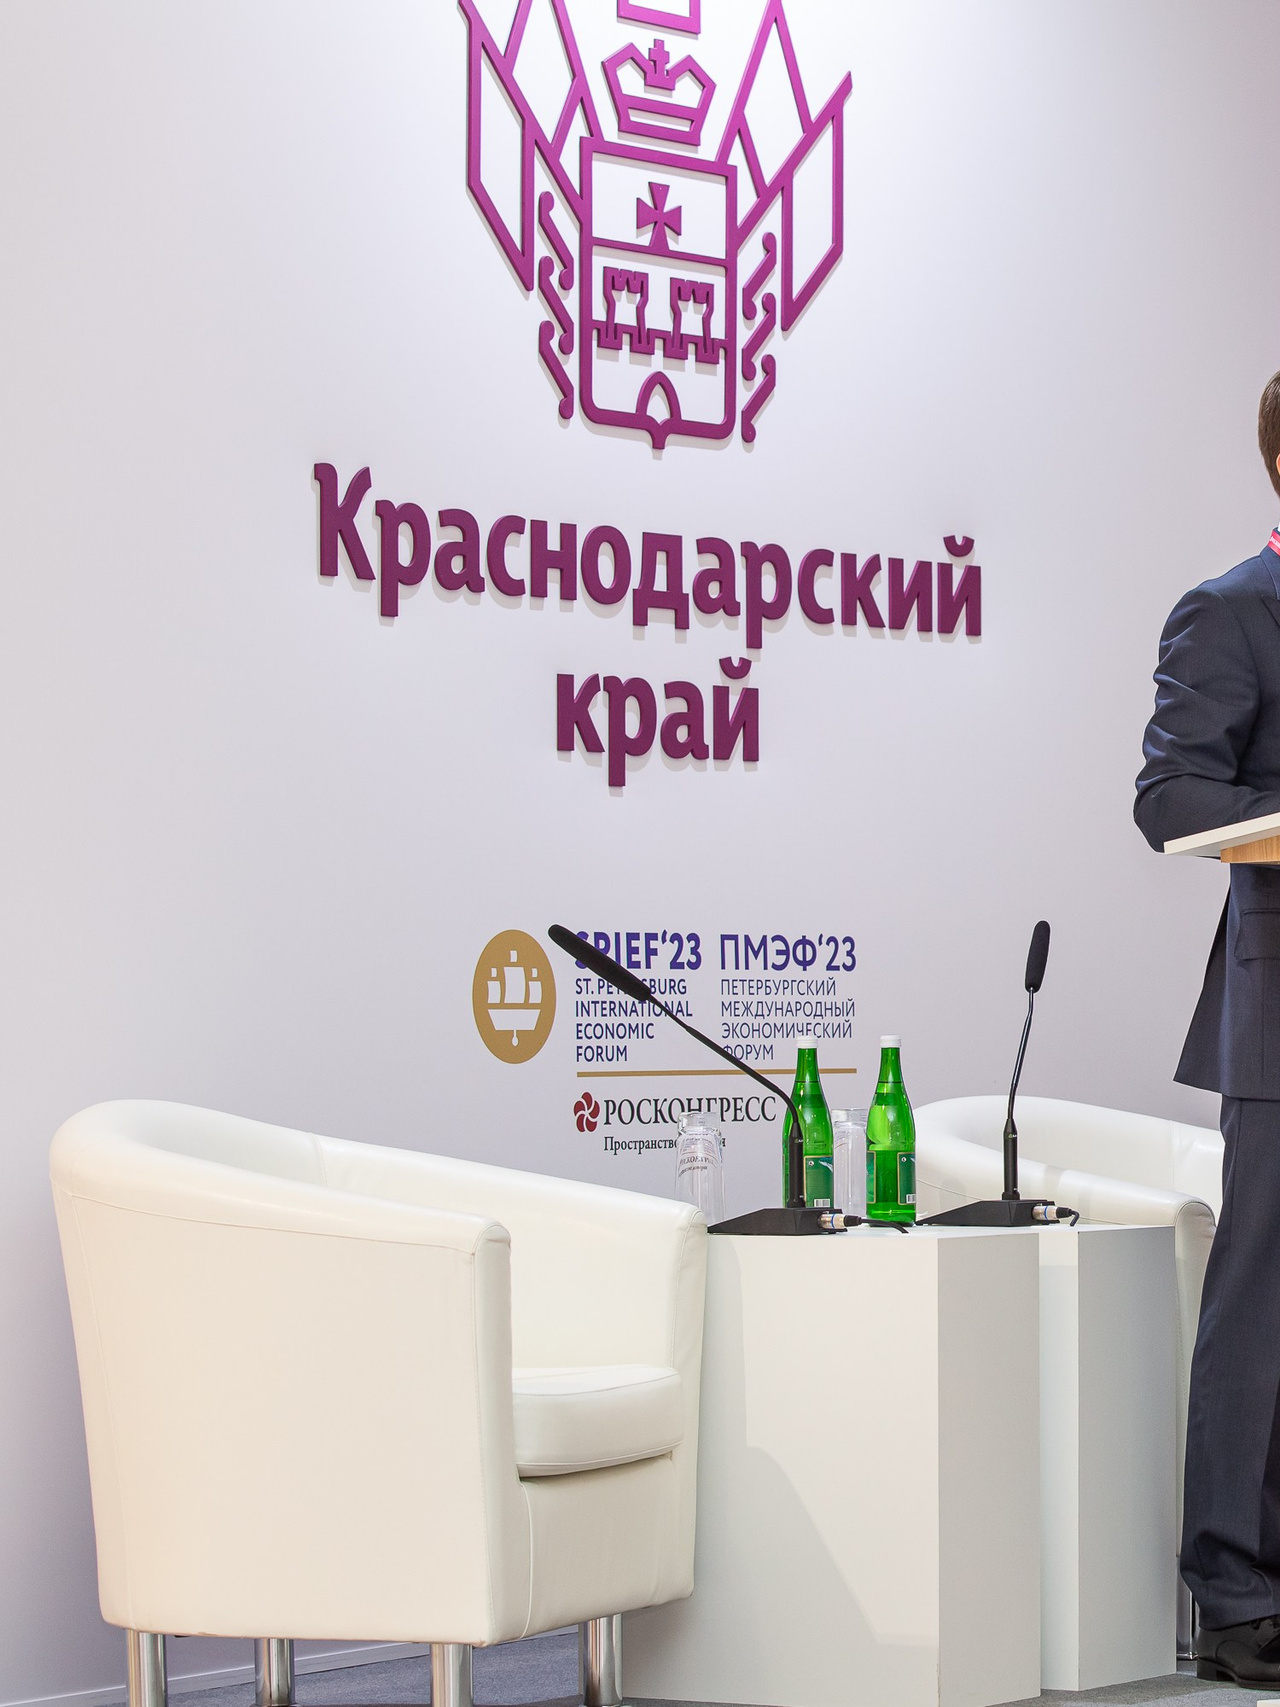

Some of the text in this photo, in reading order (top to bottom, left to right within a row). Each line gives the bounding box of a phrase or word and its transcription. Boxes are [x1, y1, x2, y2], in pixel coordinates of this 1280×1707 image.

[314, 462, 982, 649] Краснодарский
[557, 656, 759, 787] край
[575, 978, 594, 995] ST.
[721, 977, 836, 996] ПЕТЕРБУРГСКИЙ
[575, 1000, 693, 1018] INTERNATIONAL
[721, 998, 855, 1020] МЕЖДУНАРОДНЫЙ
[576, 1022, 655, 1040] ECONOMIC
[721, 1019, 852, 1039] ЭКОНОМИЧЕСКИЙ
[576, 1045, 628, 1062] FORUM
